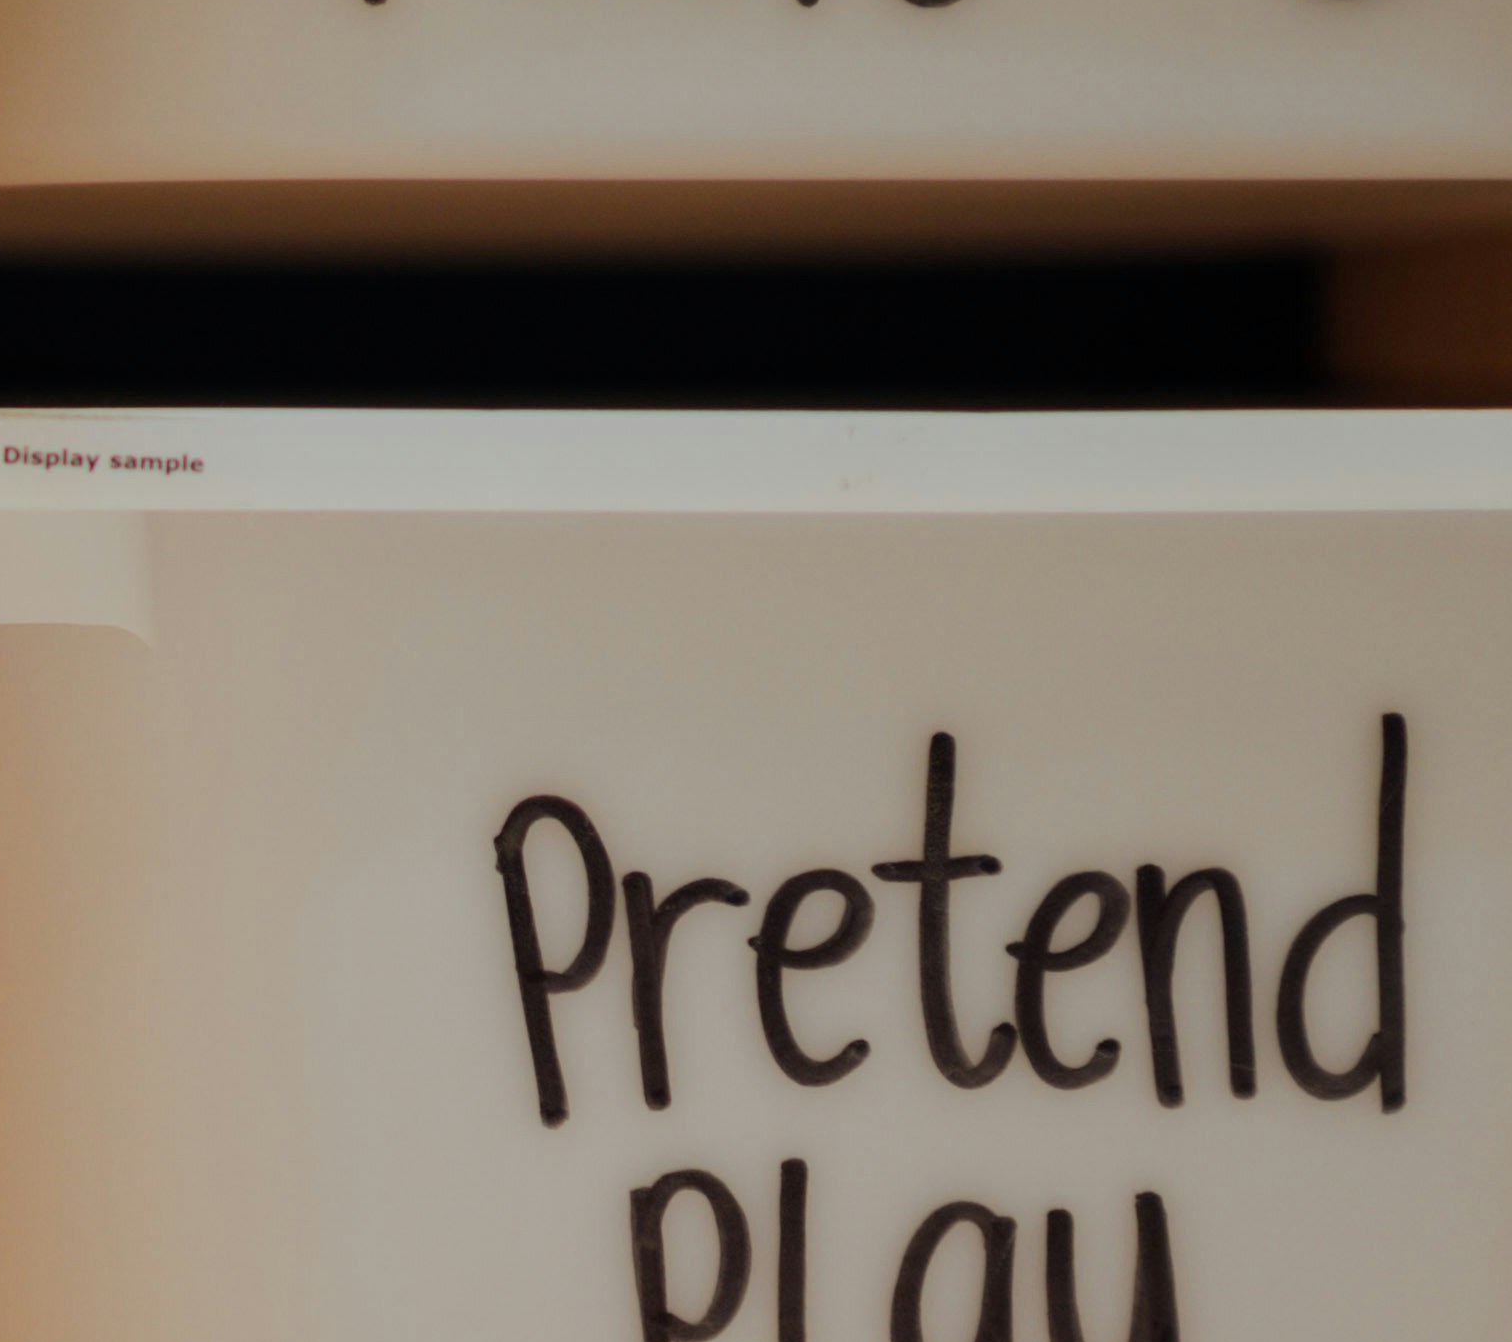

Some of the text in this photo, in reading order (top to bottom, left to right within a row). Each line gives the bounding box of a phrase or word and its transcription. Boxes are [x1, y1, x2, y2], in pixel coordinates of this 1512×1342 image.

[3, 446, 204, 475] Display sample
[493, 711, 1408, 1127] Pretend
